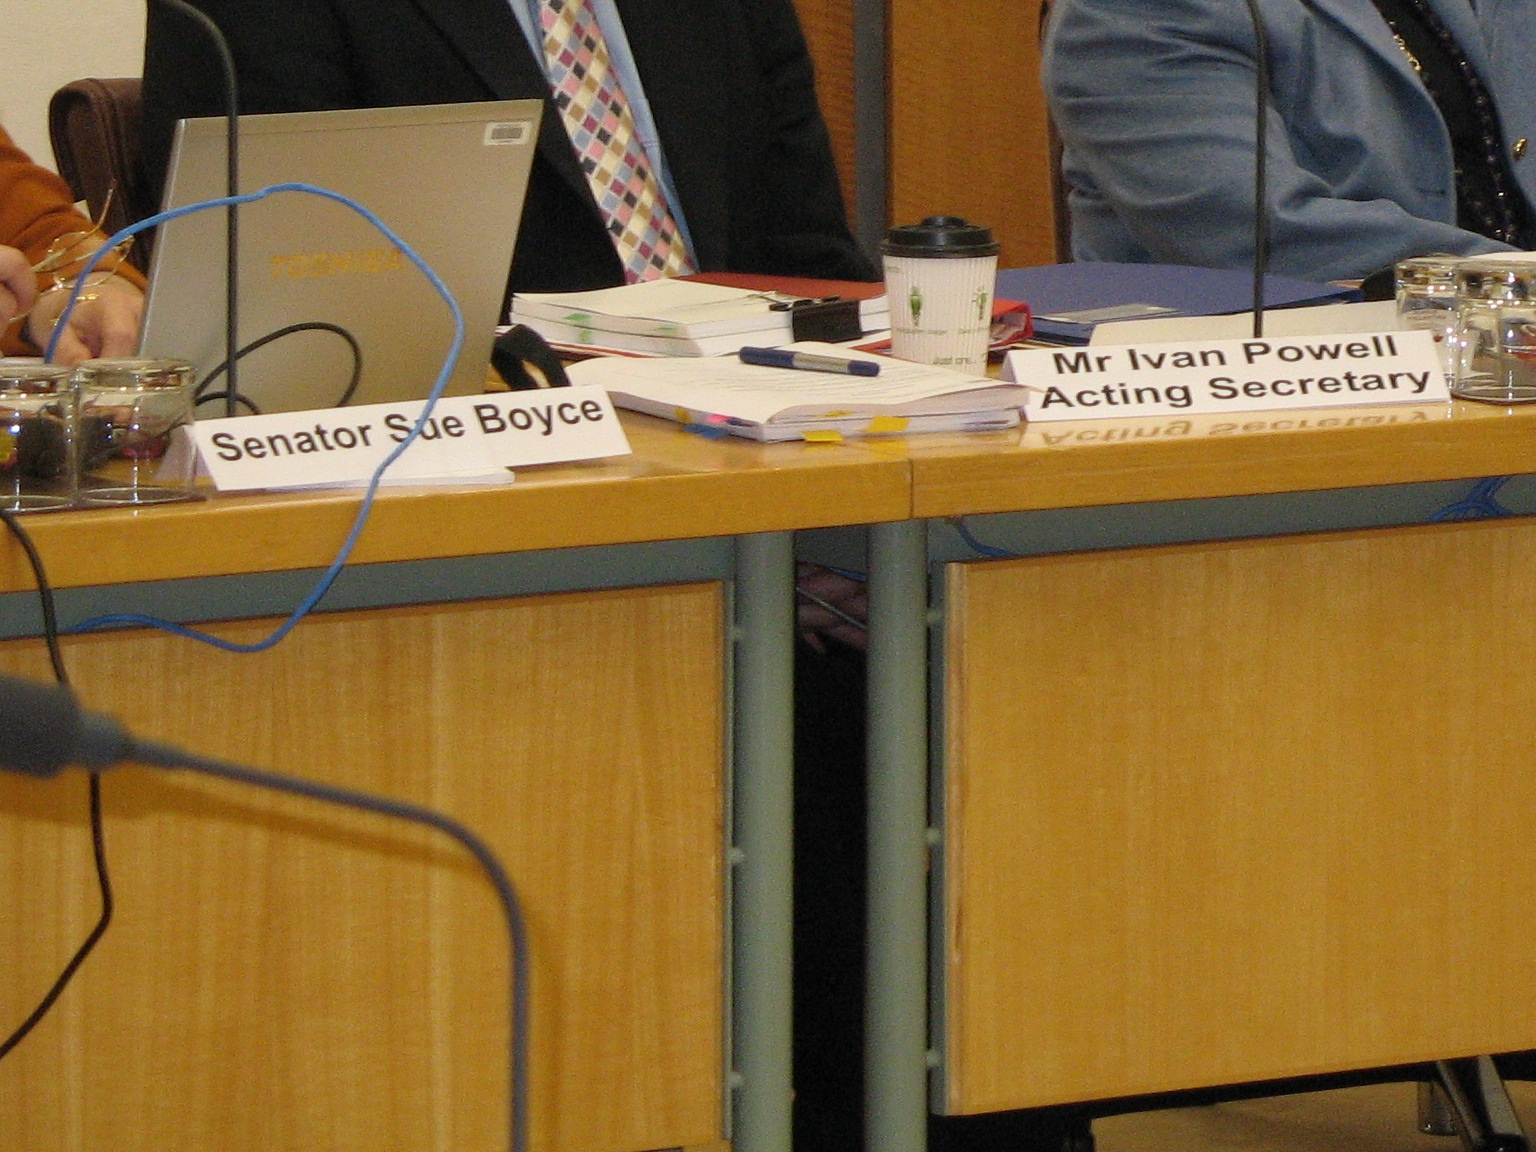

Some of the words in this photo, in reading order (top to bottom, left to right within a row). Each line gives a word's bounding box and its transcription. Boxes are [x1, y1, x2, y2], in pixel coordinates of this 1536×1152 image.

[1053, 351, 1112, 375] Mr
[1129, 346, 1227, 371] Ivan
[1241, 334, 1398, 365] Powell
[1040, 383, 1193, 409] Acting
[1209, 370, 1432, 400] Secretary
[211, 422, 372, 462] Senator
[384, 412, 466, 443] Sue
[473, 398, 604, 436] Boyce
